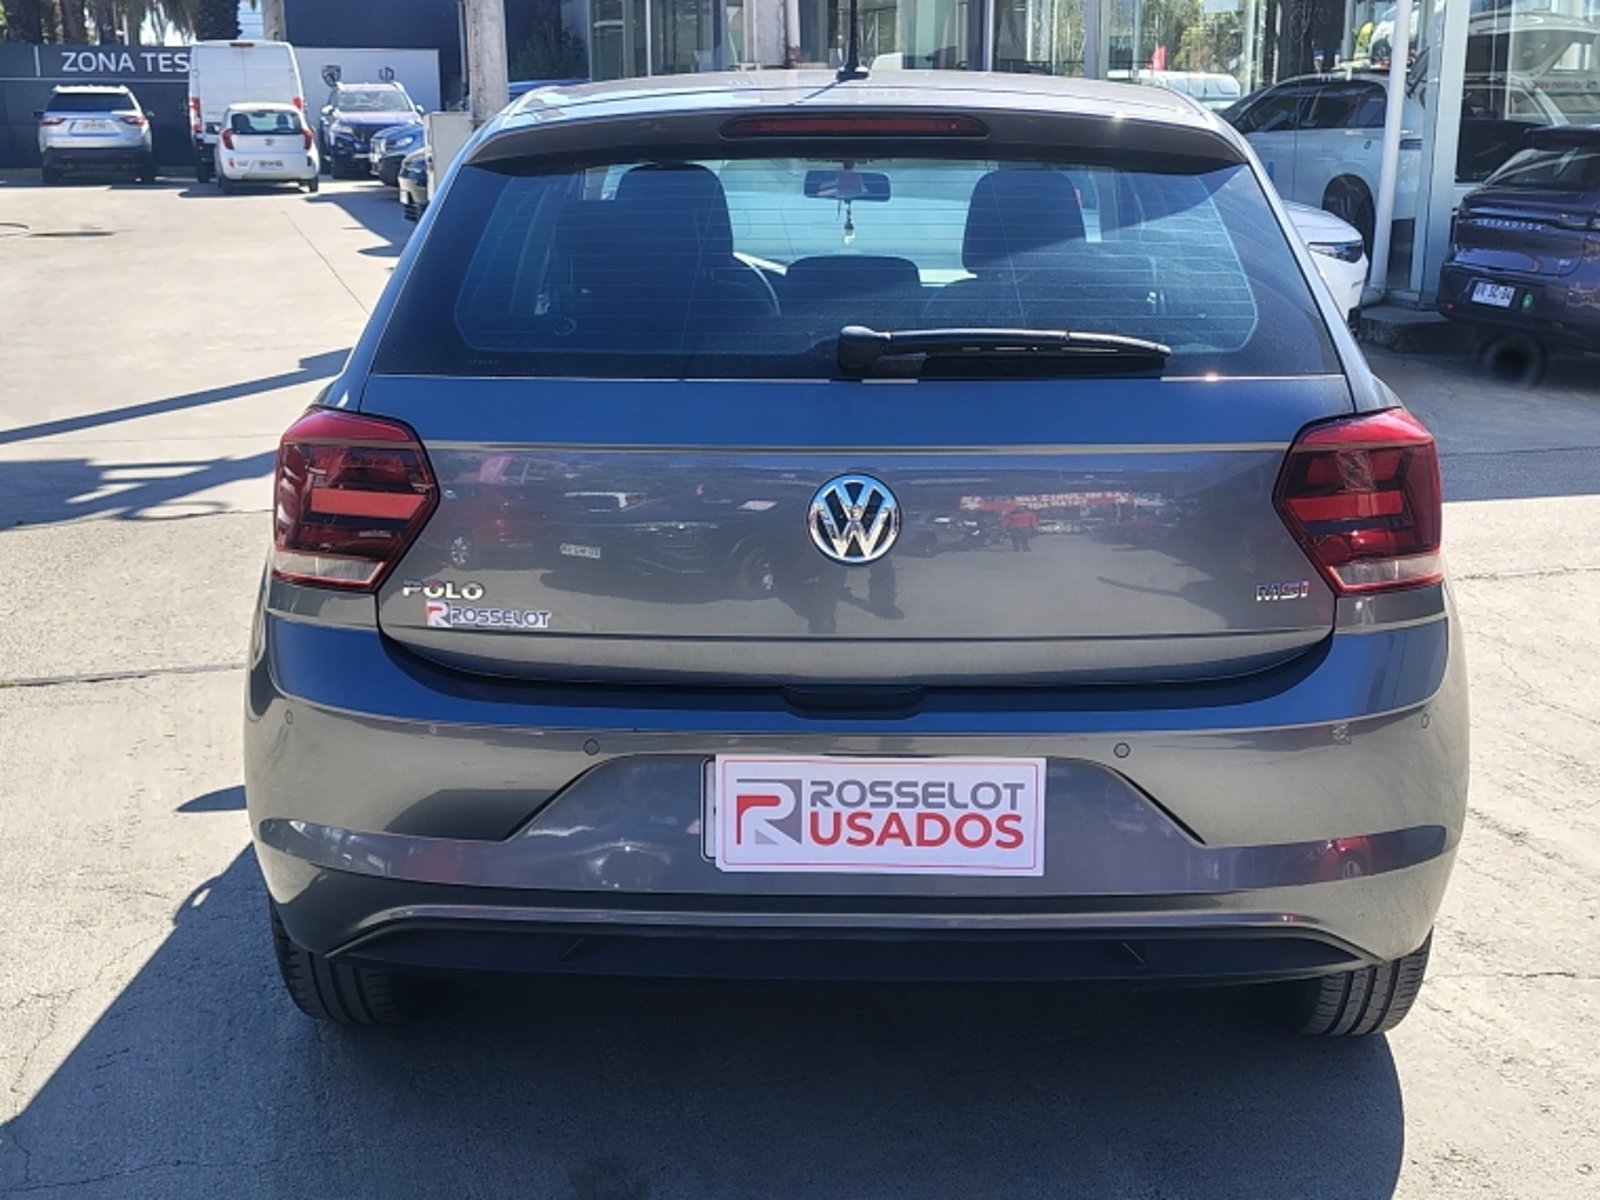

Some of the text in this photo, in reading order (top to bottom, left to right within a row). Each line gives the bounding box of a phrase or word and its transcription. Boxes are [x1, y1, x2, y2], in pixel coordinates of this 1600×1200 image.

[61, 52, 136, 73] ZONA
[402, 579, 484, 600] POLO
[1256, 581, 1309, 601] MSI
[452, 607, 550, 626] ROSSELOT
[810, 780, 1025, 810] ROSSELOT
[809, 811, 1025, 849] USADOS
